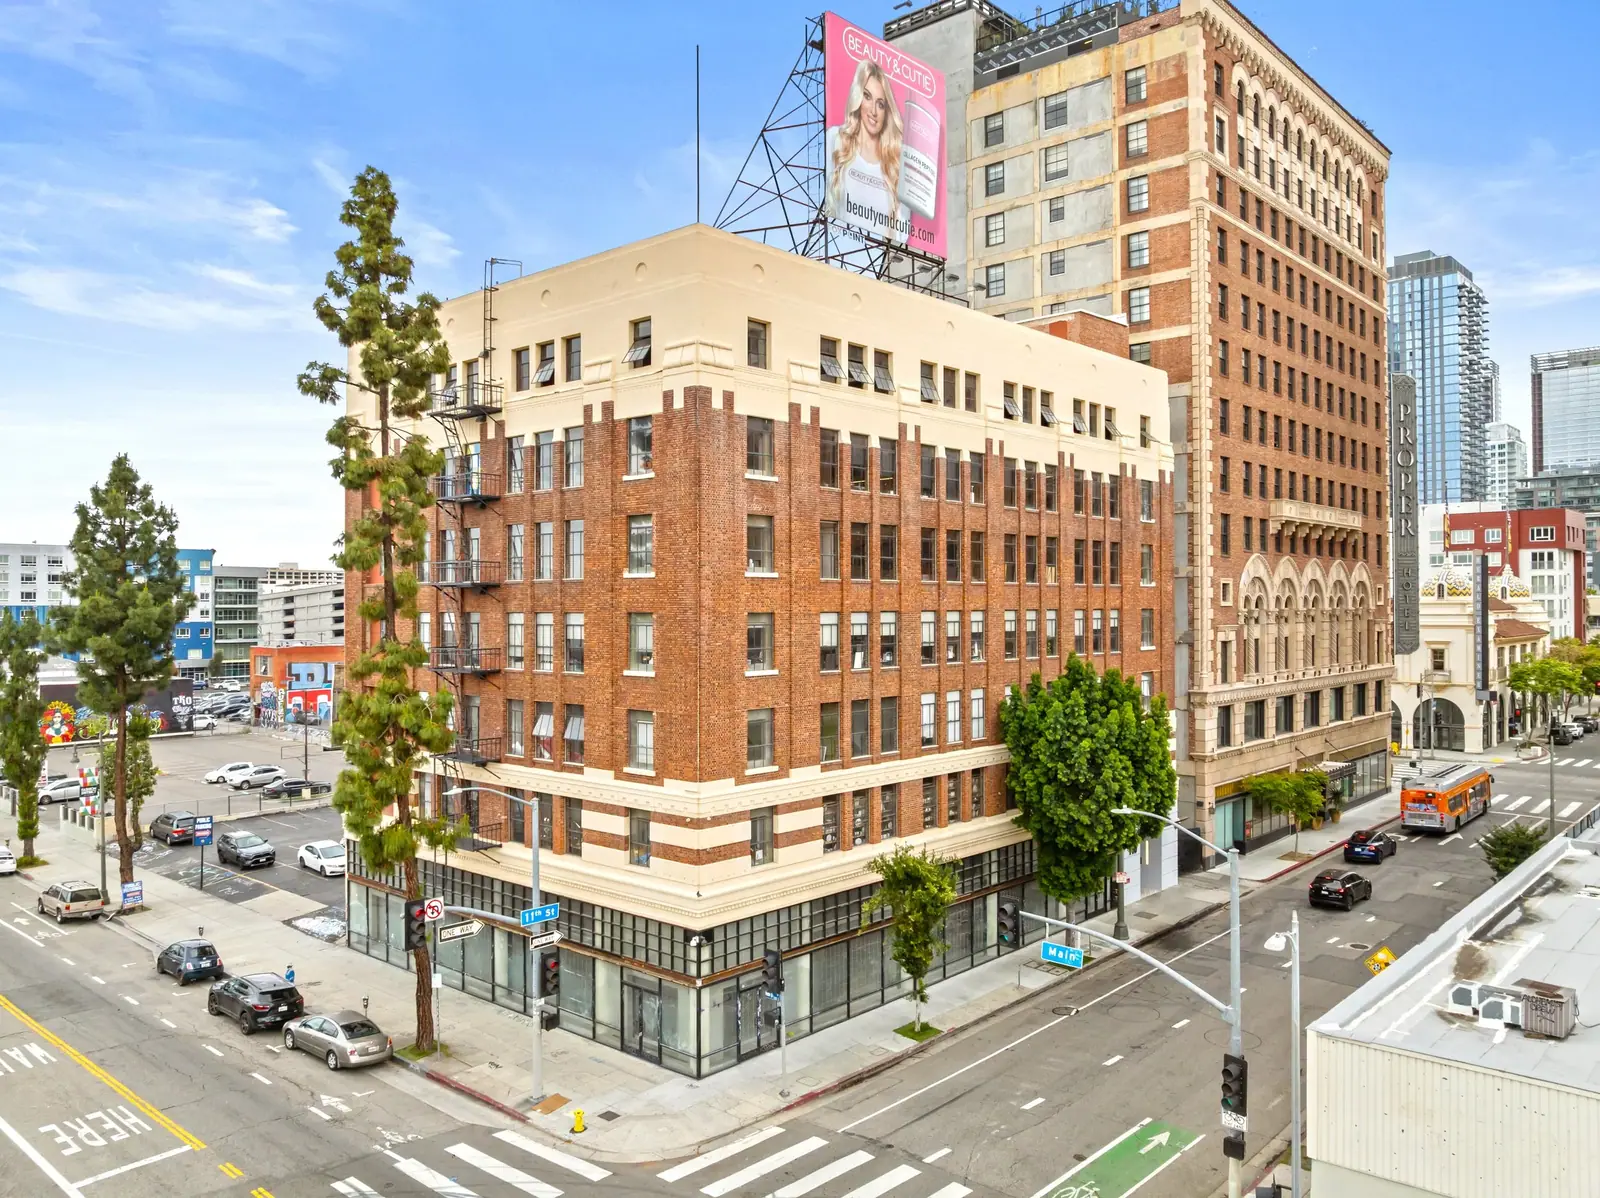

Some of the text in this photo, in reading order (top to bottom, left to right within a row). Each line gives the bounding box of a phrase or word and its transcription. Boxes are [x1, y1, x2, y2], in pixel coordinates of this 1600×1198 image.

[848, 34, 932, 92] BEAUTY&CUTIE
[846, 192, 935, 244] beautyandcutie.com
[1397, 403, 1415, 536] PROPER
[1402, 567, 1412, 631] HOTEL
[442, 924, 474, 938] ONE WAY
[525, 908, 555, 923] 11th St
[1048, 946, 1076, 962] Main
[38, 1105, 153, 1157] HERE
